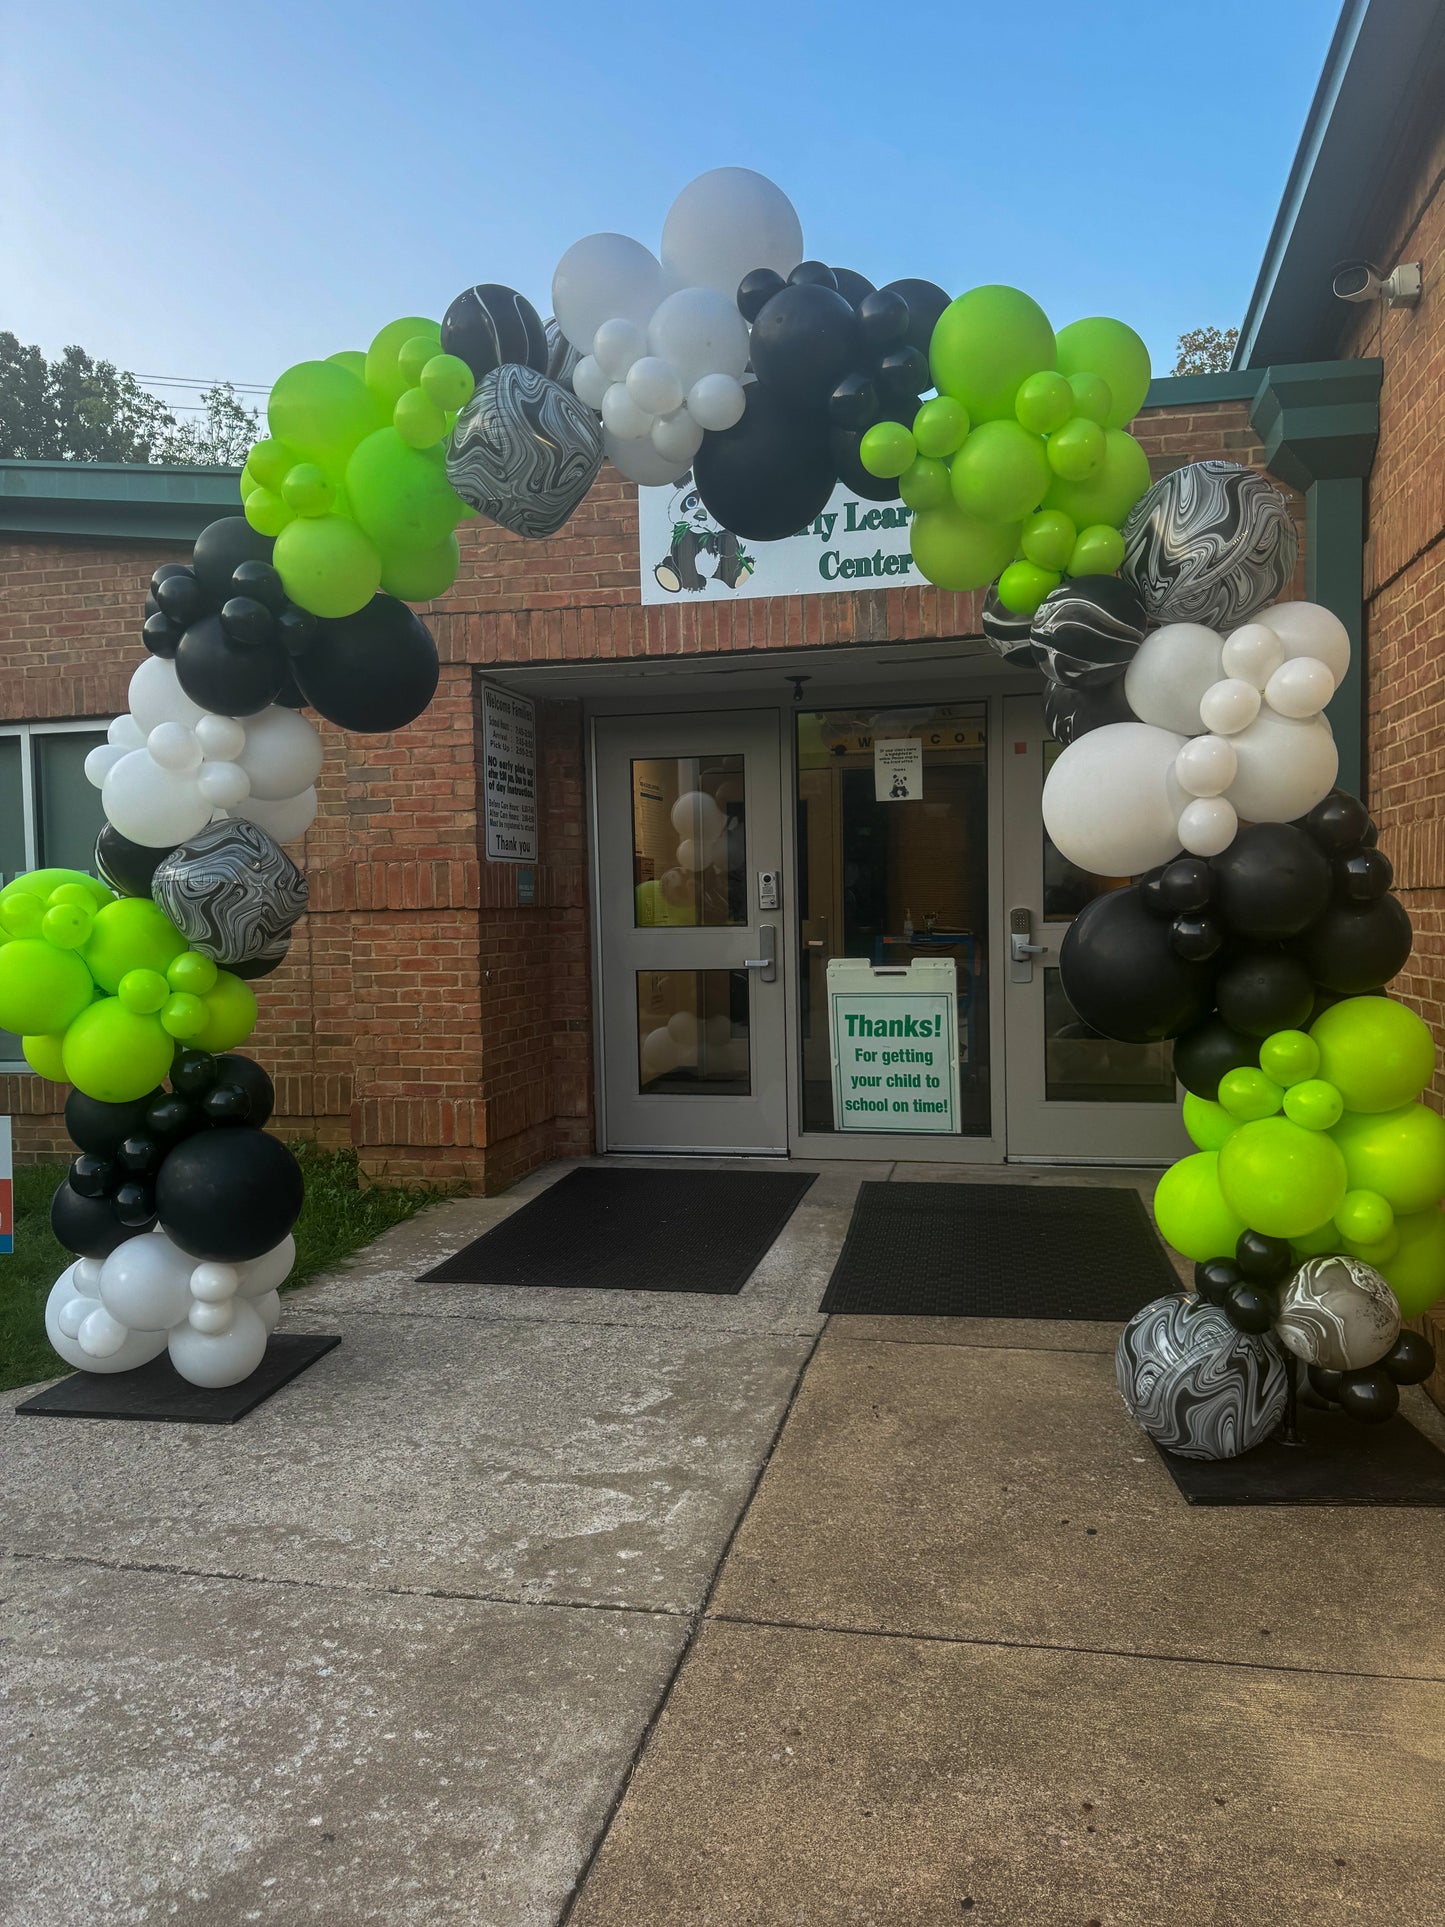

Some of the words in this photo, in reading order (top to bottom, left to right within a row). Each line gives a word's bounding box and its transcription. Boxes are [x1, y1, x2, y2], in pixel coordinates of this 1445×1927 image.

[843, 501, 914, 532] Lear
[819, 549, 914, 580] Center
[486, 691, 510, 714] Welcome
[488, 755, 498, 768] NO
[499, 761, 513, 774] early
[488, 780, 494, 791] of
[496, 781, 506, 795] day
[496, 834, 517, 851] Thank
[519, 841, 531, 856] you
[844, 1014, 941, 1038] Thanks!
[855, 1048, 878, 1062] For
[882, 1049, 933, 1065] getting
[851, 1076, 882, 1089] your
[886, 1074, 921, 1088] child
[925, 1076, 940, 1088] to
[845, 1098, 888, 1111] school
[892, 1102, 909, 1112] on
[912, 1100, 948, 1113] time!
